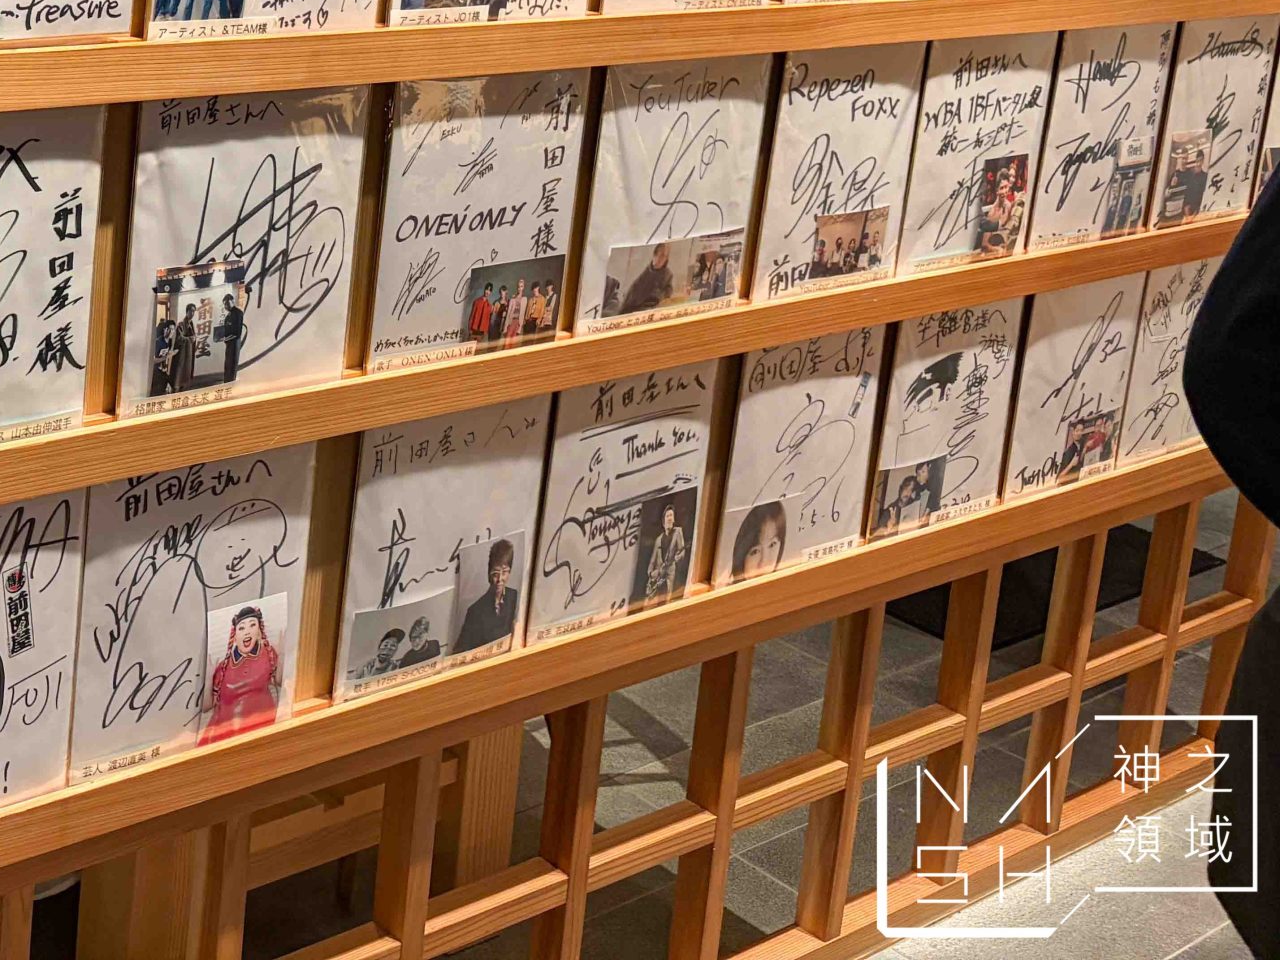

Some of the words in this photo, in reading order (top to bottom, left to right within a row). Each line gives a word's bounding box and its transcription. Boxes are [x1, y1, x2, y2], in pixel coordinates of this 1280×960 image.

[158, 27, 217, 39] アーティスト
[221, 22, 269, 37] &TEAM様
[629, 66, 740, 123] YouTuber
[788, 62, 875, 112] Repezen
[531, 82, 579, 258] 前田屋様
[621, 430, 666, 465] Thank
